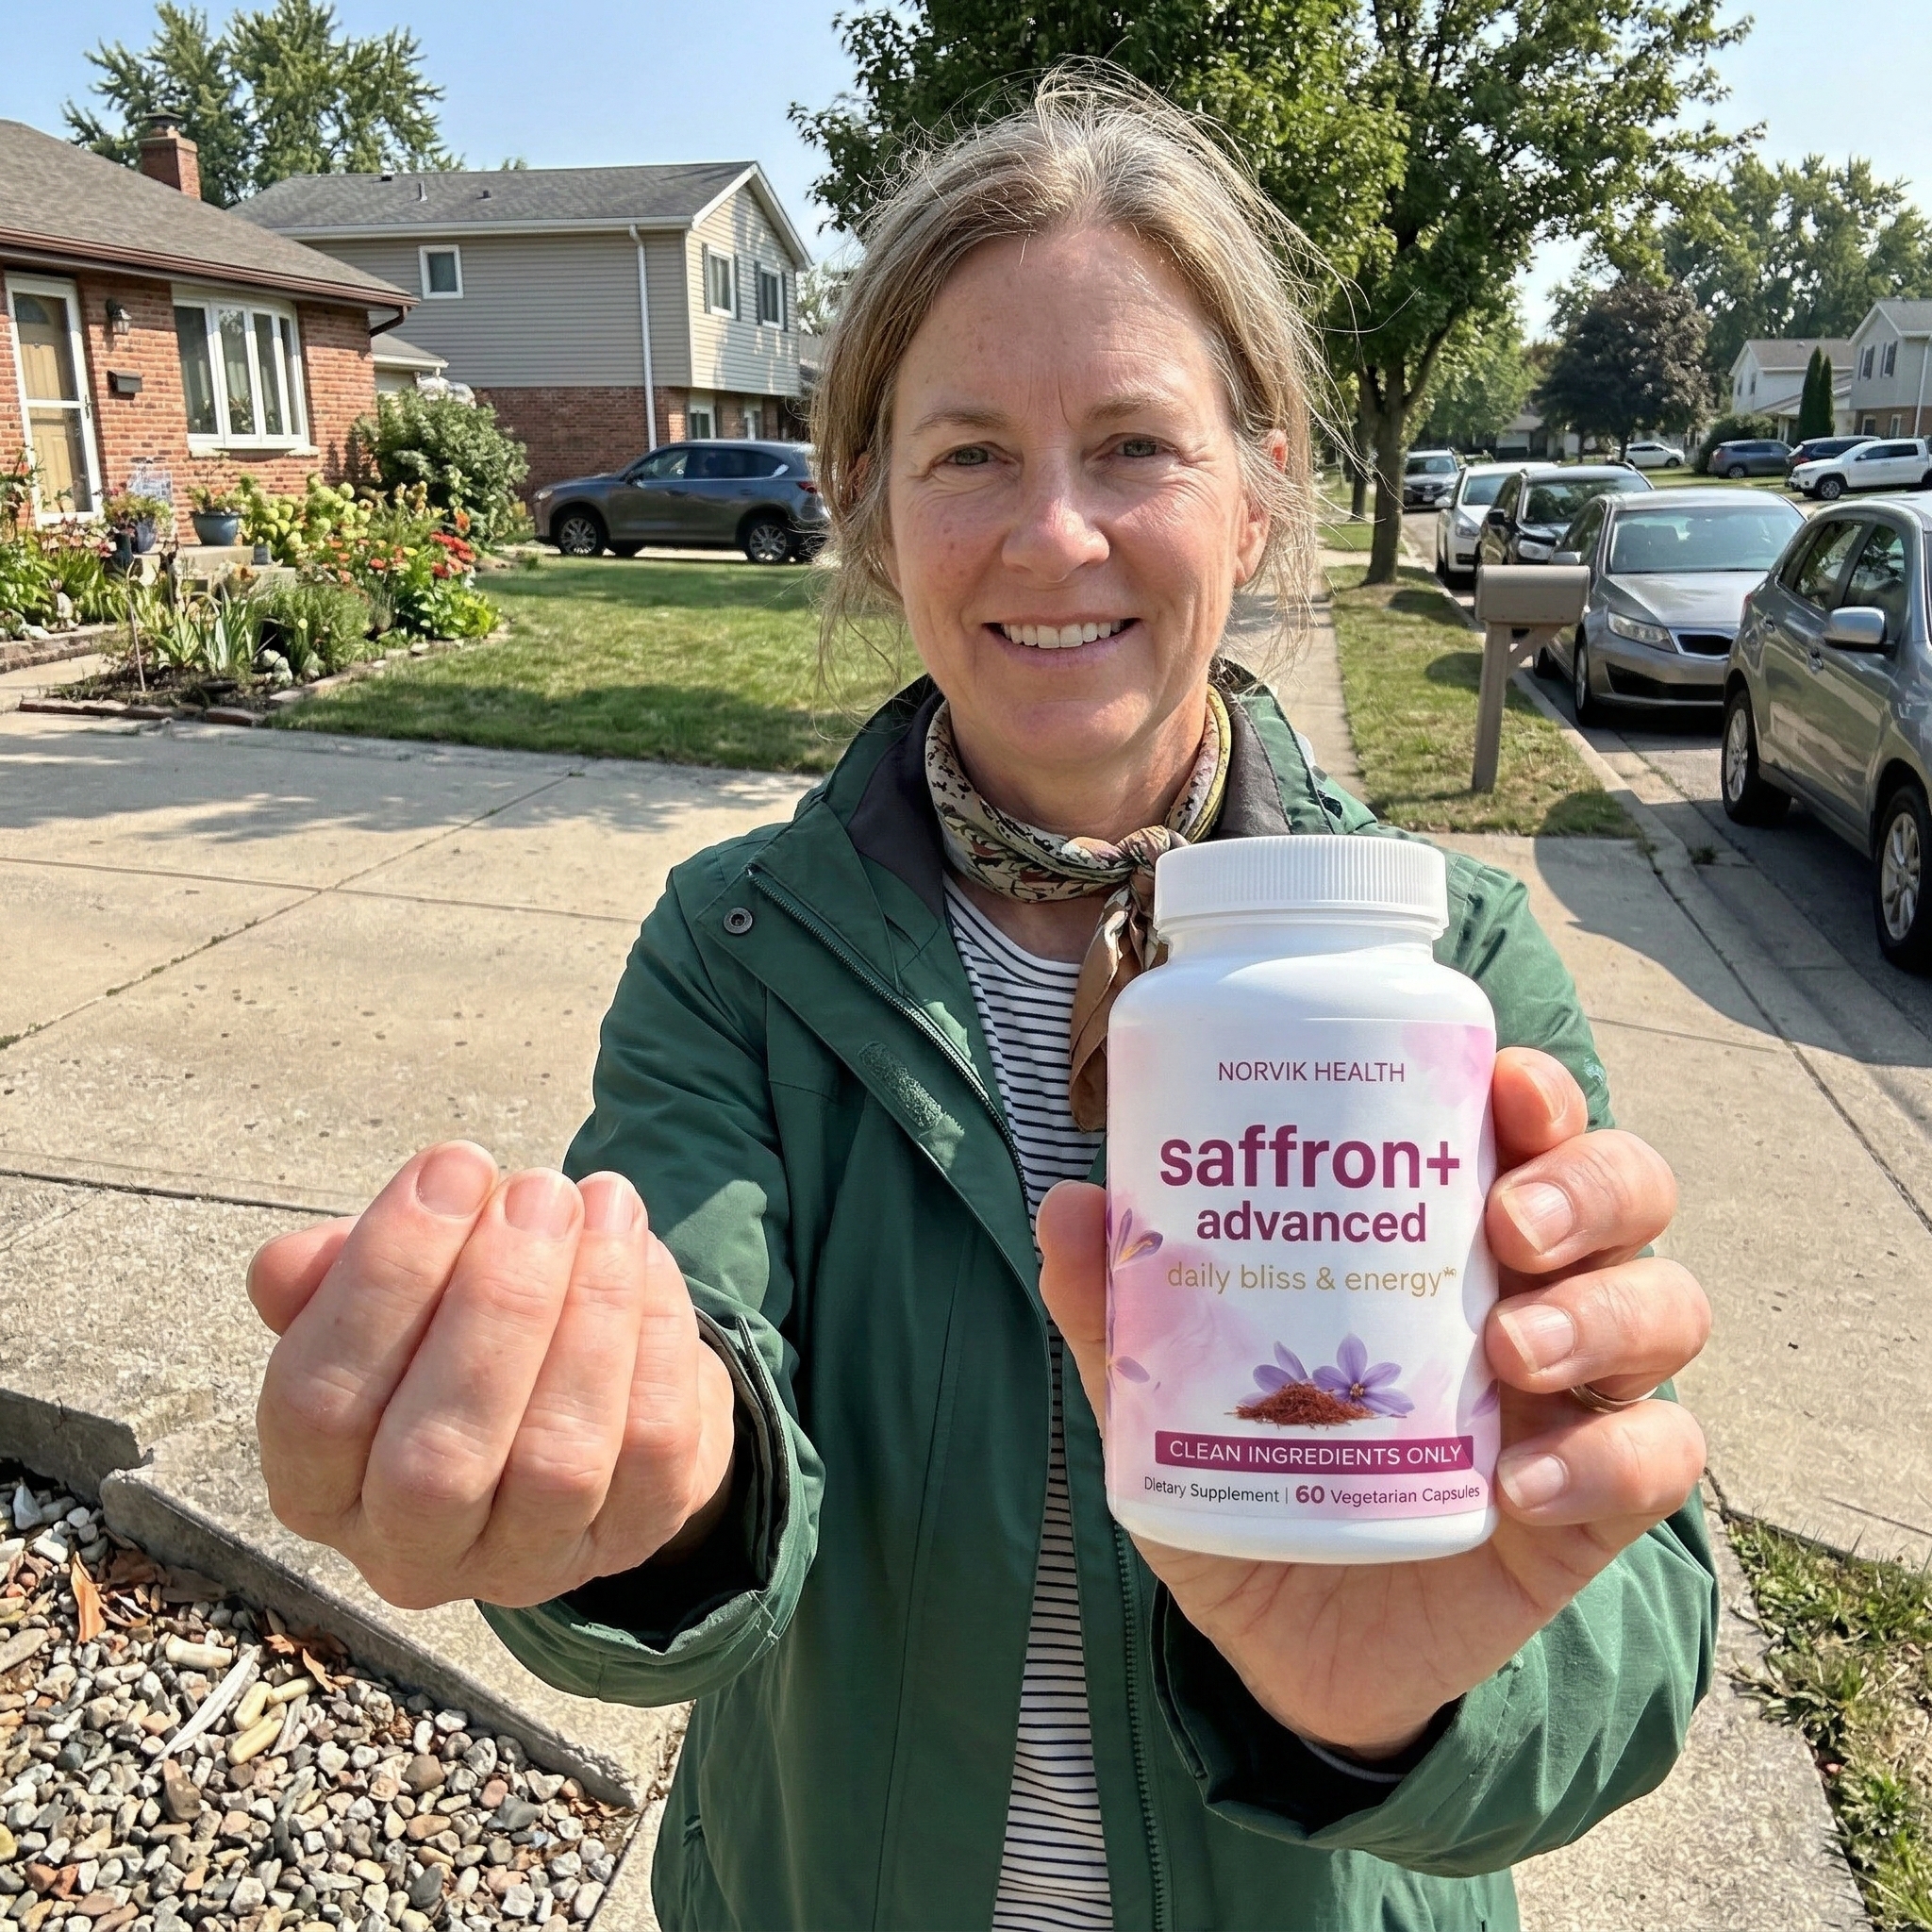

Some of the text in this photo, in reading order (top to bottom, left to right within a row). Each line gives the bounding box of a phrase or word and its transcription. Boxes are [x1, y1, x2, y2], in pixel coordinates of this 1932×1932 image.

[1219, 1061, 1405, 1083] NORVIK HEALTH
[1160, 1124, 1460, 1189] saffron+
[1196, 1201, 1426, 1242] advanced
[1168, 1261, 1230, 1295] daily
[1241, 1264, 1307, 1291] bliss
[1316, 1267, 1336, 1291] &
[1170, 1440, 1462, 1465] CLEAN INGREDIENTS ONLY
[1191, 1483, 1280, 1503] Supplement
[1295, 1485, 1325, 1505] 60
[1330, 1489, 1417, 1507] Vegetarian
[1422, 1484, 1480, 1505] Capsules
